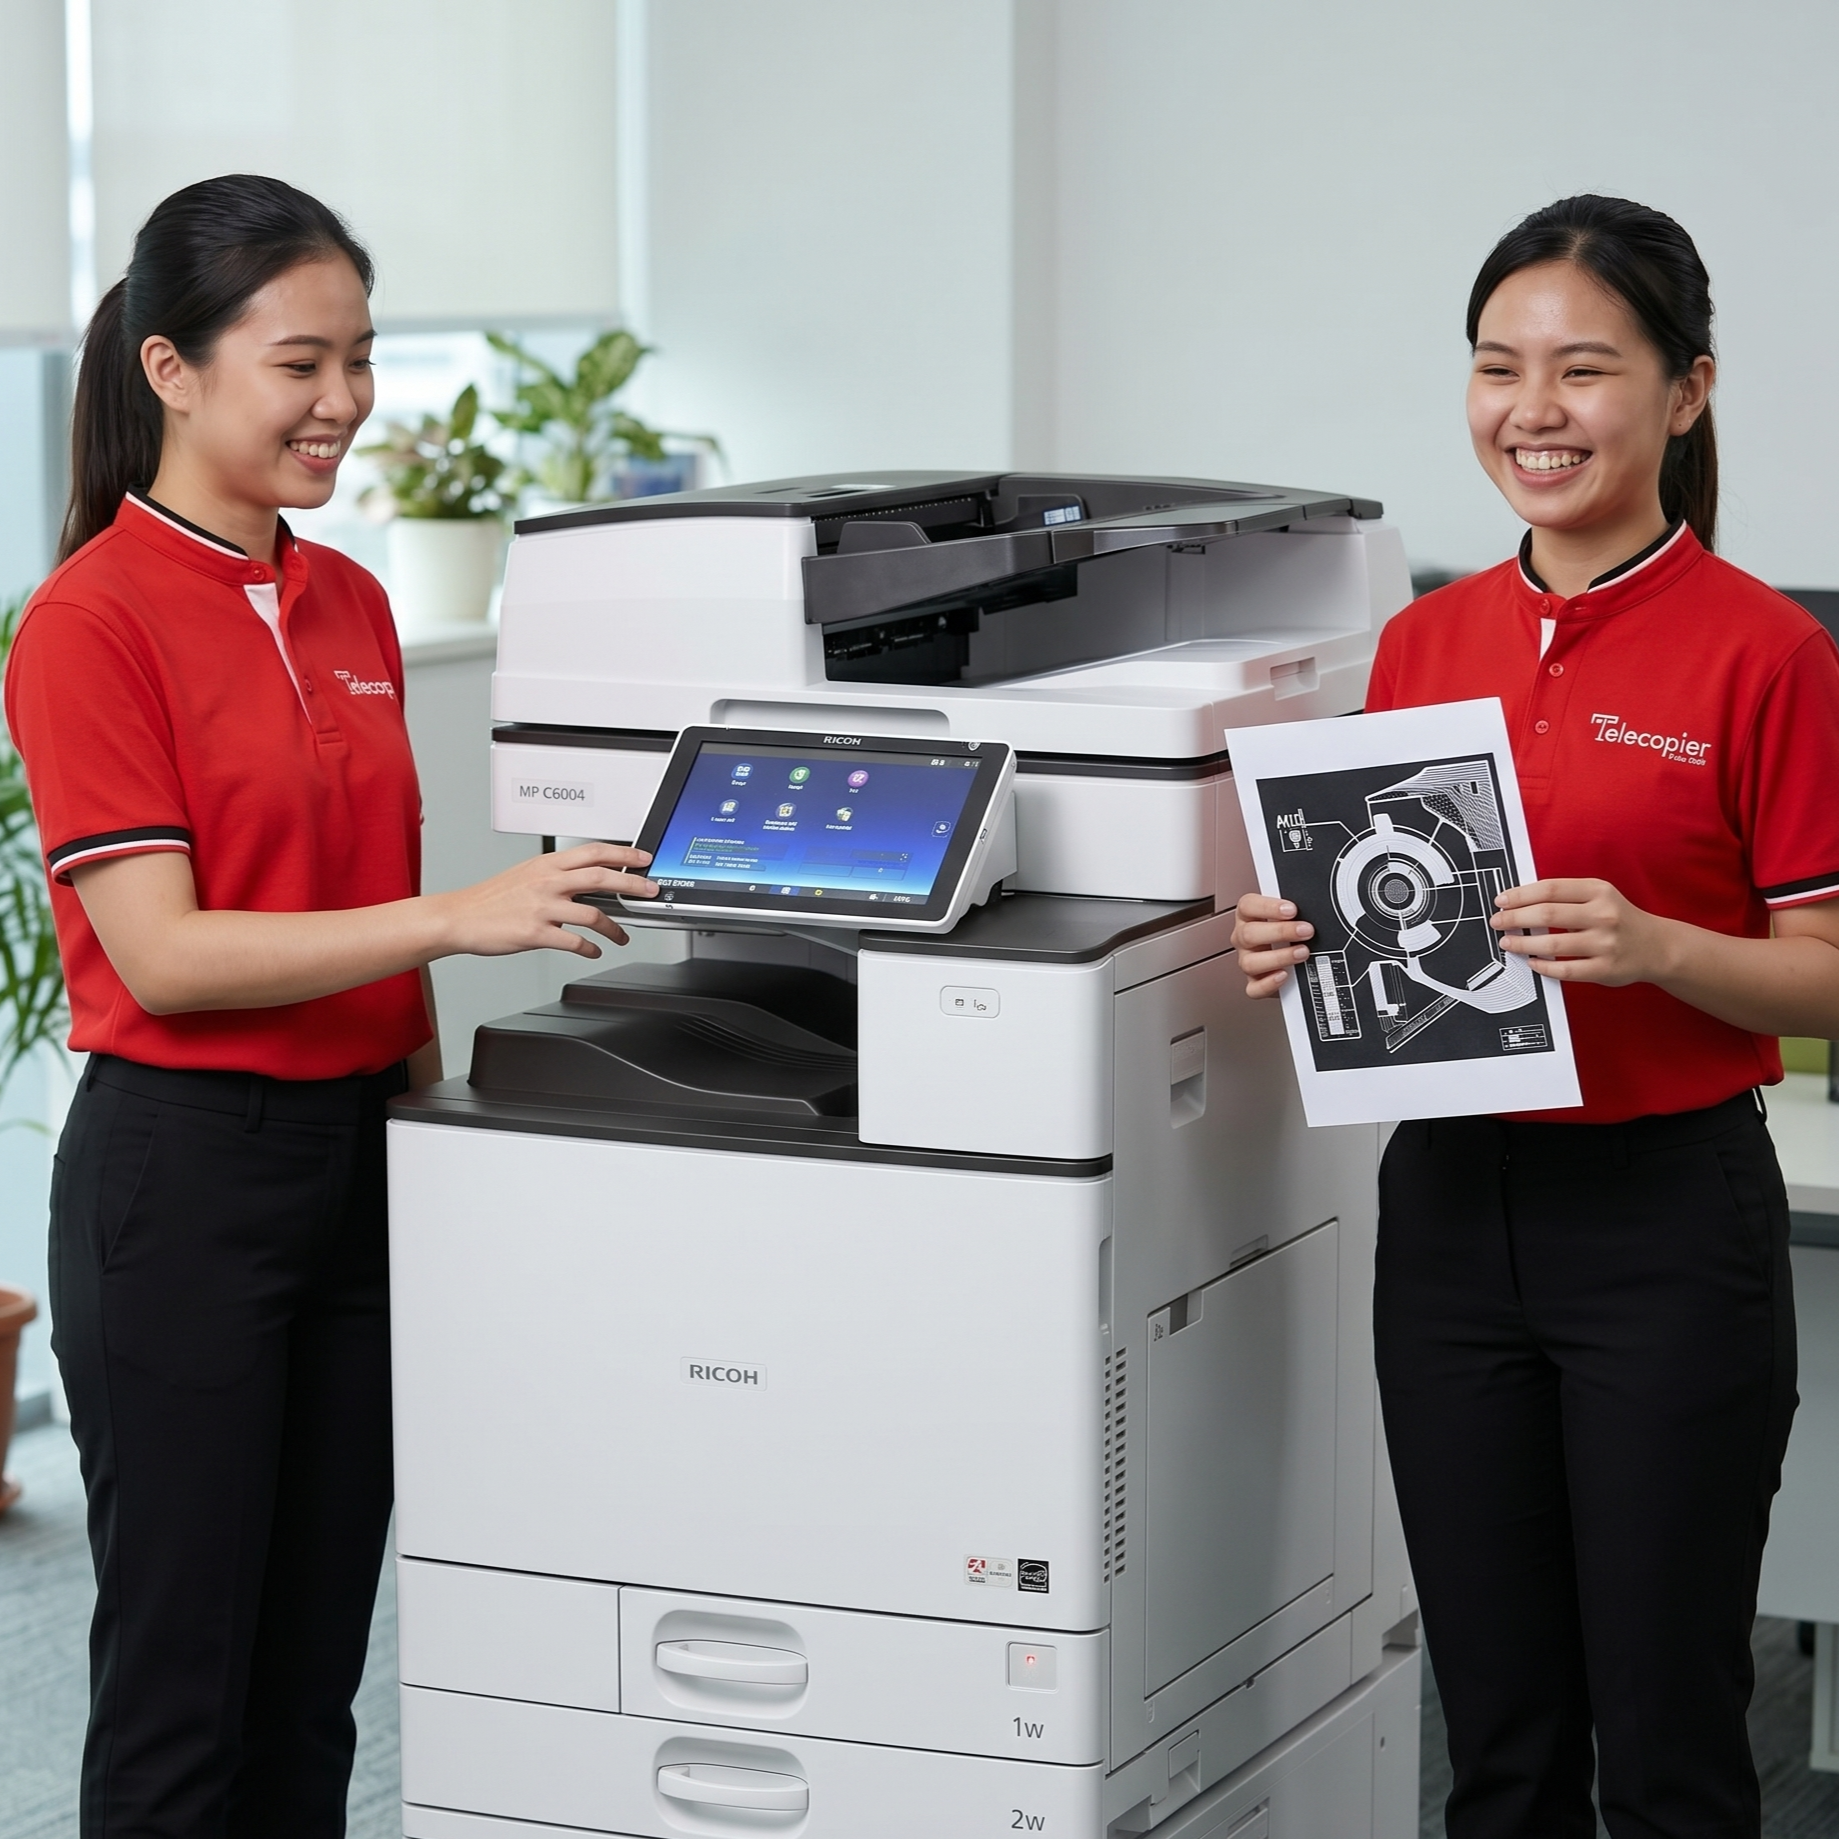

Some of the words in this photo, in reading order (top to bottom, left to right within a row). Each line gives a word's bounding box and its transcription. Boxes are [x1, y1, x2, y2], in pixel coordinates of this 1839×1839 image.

[823, 735, 862, 746] RICOH
[1590, 713, 1712, 757] Telecopier
[519, 785, 540, 798] MP
[543, 786, 585, 801] C6004
[689, 1364, 758, 1385] RICOH
